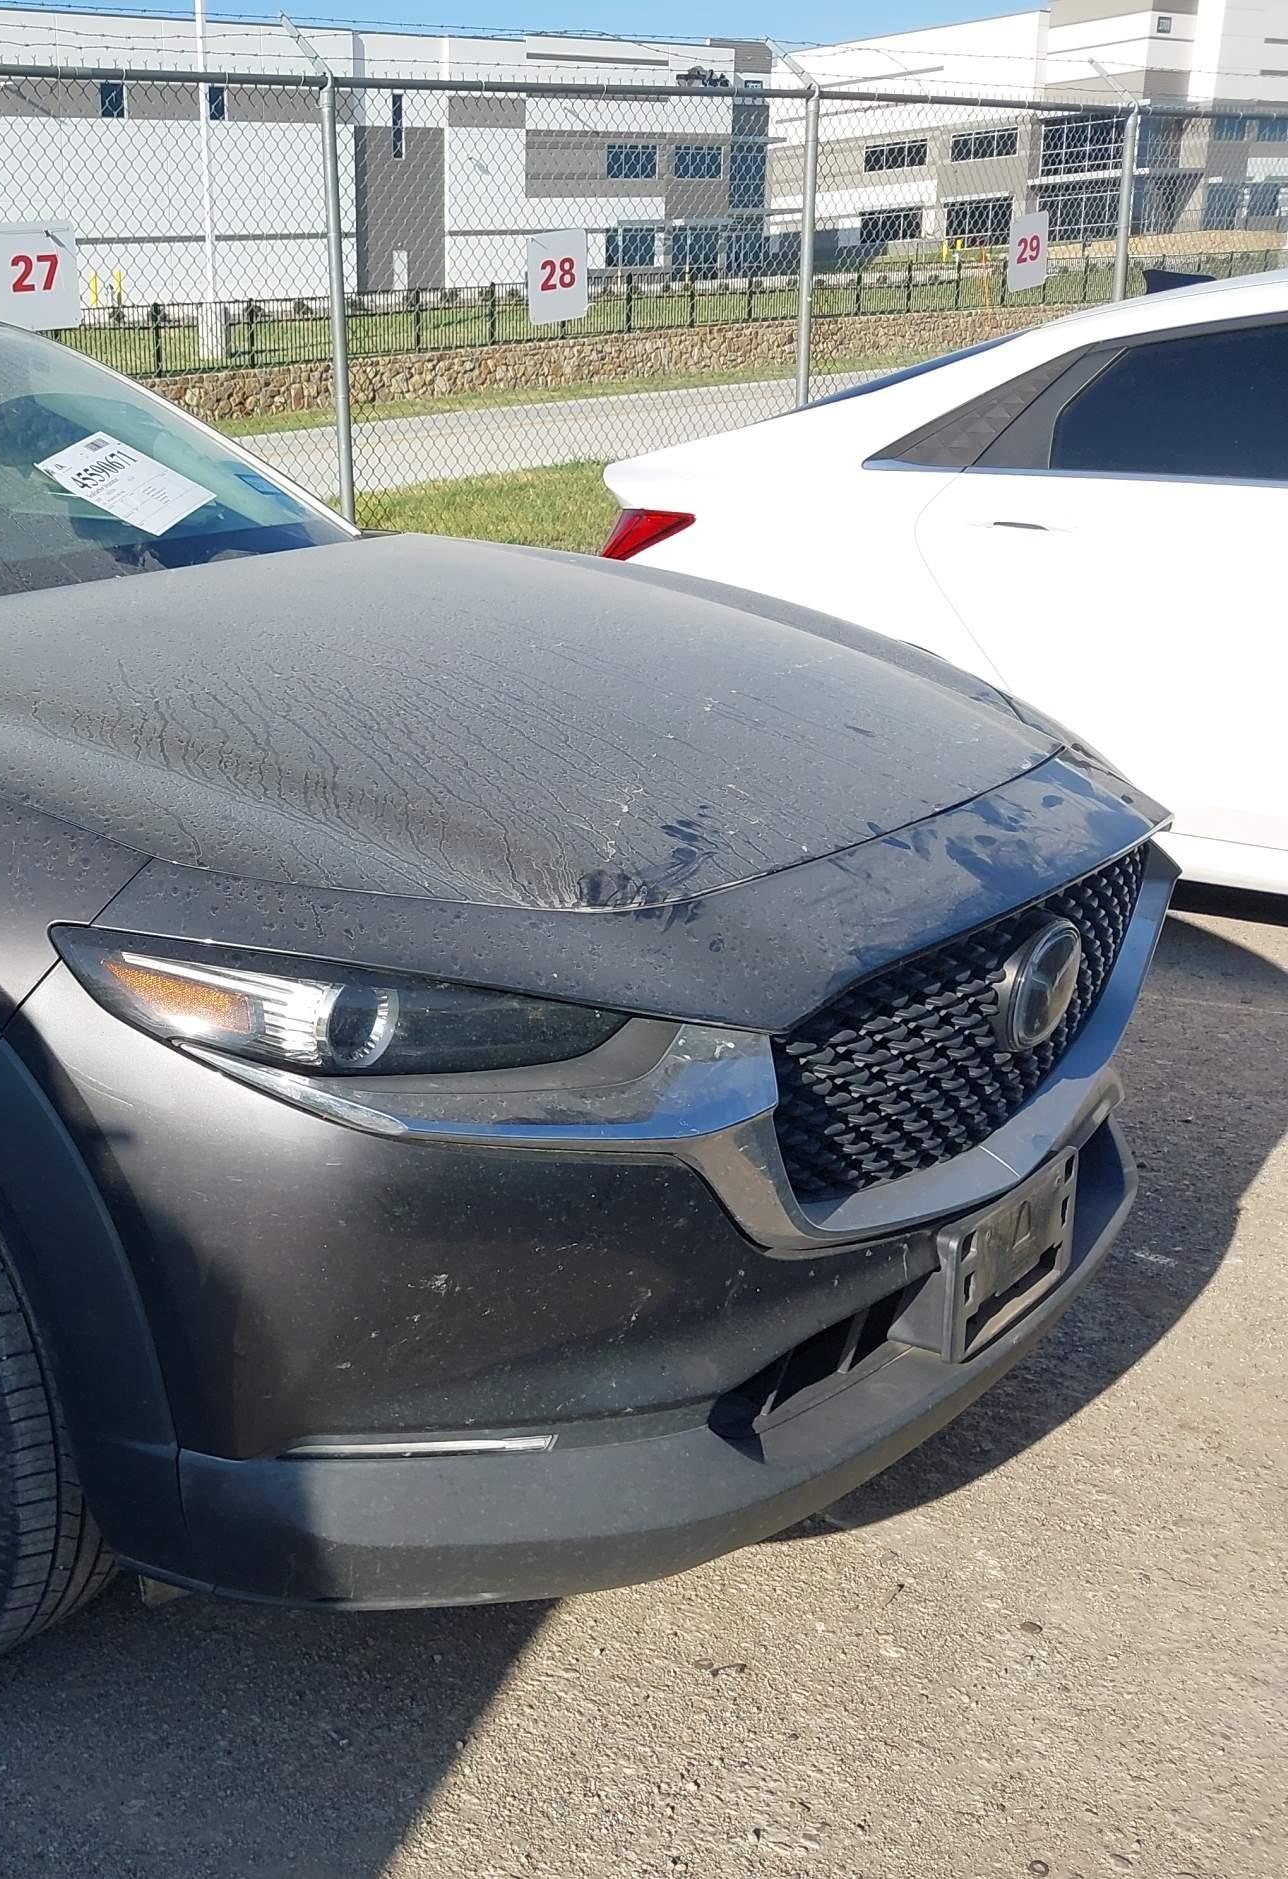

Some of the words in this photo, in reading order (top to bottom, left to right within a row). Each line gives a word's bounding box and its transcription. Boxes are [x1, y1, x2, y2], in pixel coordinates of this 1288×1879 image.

[1017, 235, 1040, 264] 29
[11, 254, 58, 293] 27
[541, 257, 576, 291] 28
[71, 450, 138, 489] 45590671
